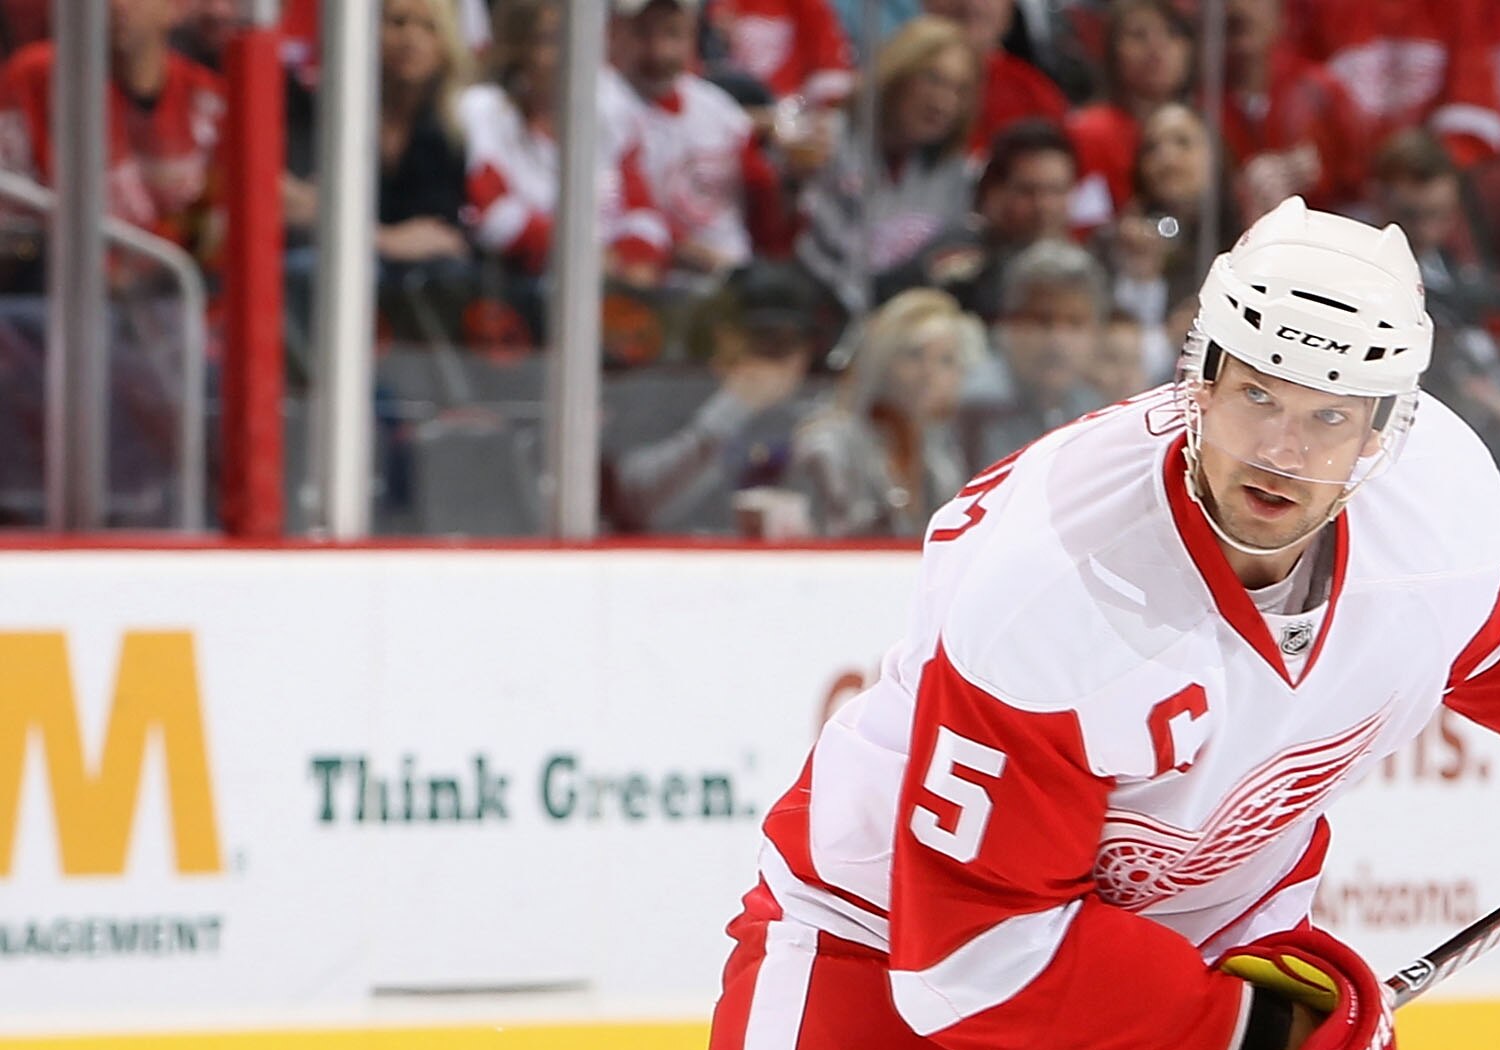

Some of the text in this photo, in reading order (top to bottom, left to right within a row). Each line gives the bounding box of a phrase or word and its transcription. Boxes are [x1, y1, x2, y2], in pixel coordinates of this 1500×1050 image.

[1275, 325, 1352, 356] CCM
[1145, 682, 1209, 780] C
[308, 750, 757, 823] Think Green.
[909, 724, 1008, 865] 5
